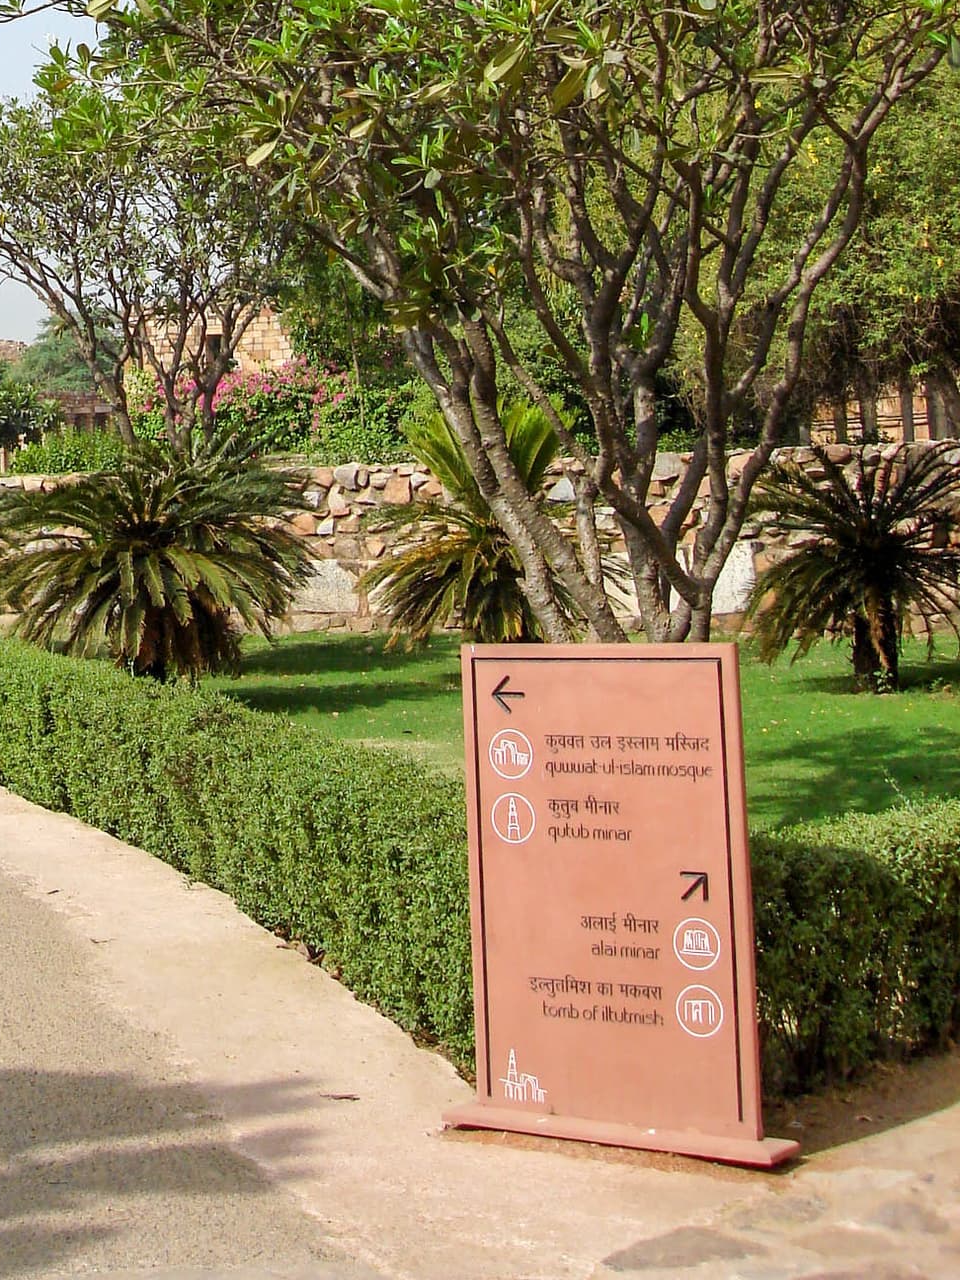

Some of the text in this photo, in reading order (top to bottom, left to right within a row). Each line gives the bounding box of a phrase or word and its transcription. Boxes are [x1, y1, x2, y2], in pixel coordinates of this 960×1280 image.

[589, 735, 612, 751] उल
[616, 736, 660, 753] इस्लाम
[664, 731, 710, 753] मस्जिद
[656, 764, 714, 783] mosque
[583, 795, 621, 816] मीनार
[547, 822, 633, 844] qutub minar
[580, 911, 660, 935] अलाई मीनार
[591, 939, 661, 961] alai minar
[596, 982, 614, 997] का
[542, 999, 665, 1027] tomb of iltutmish
